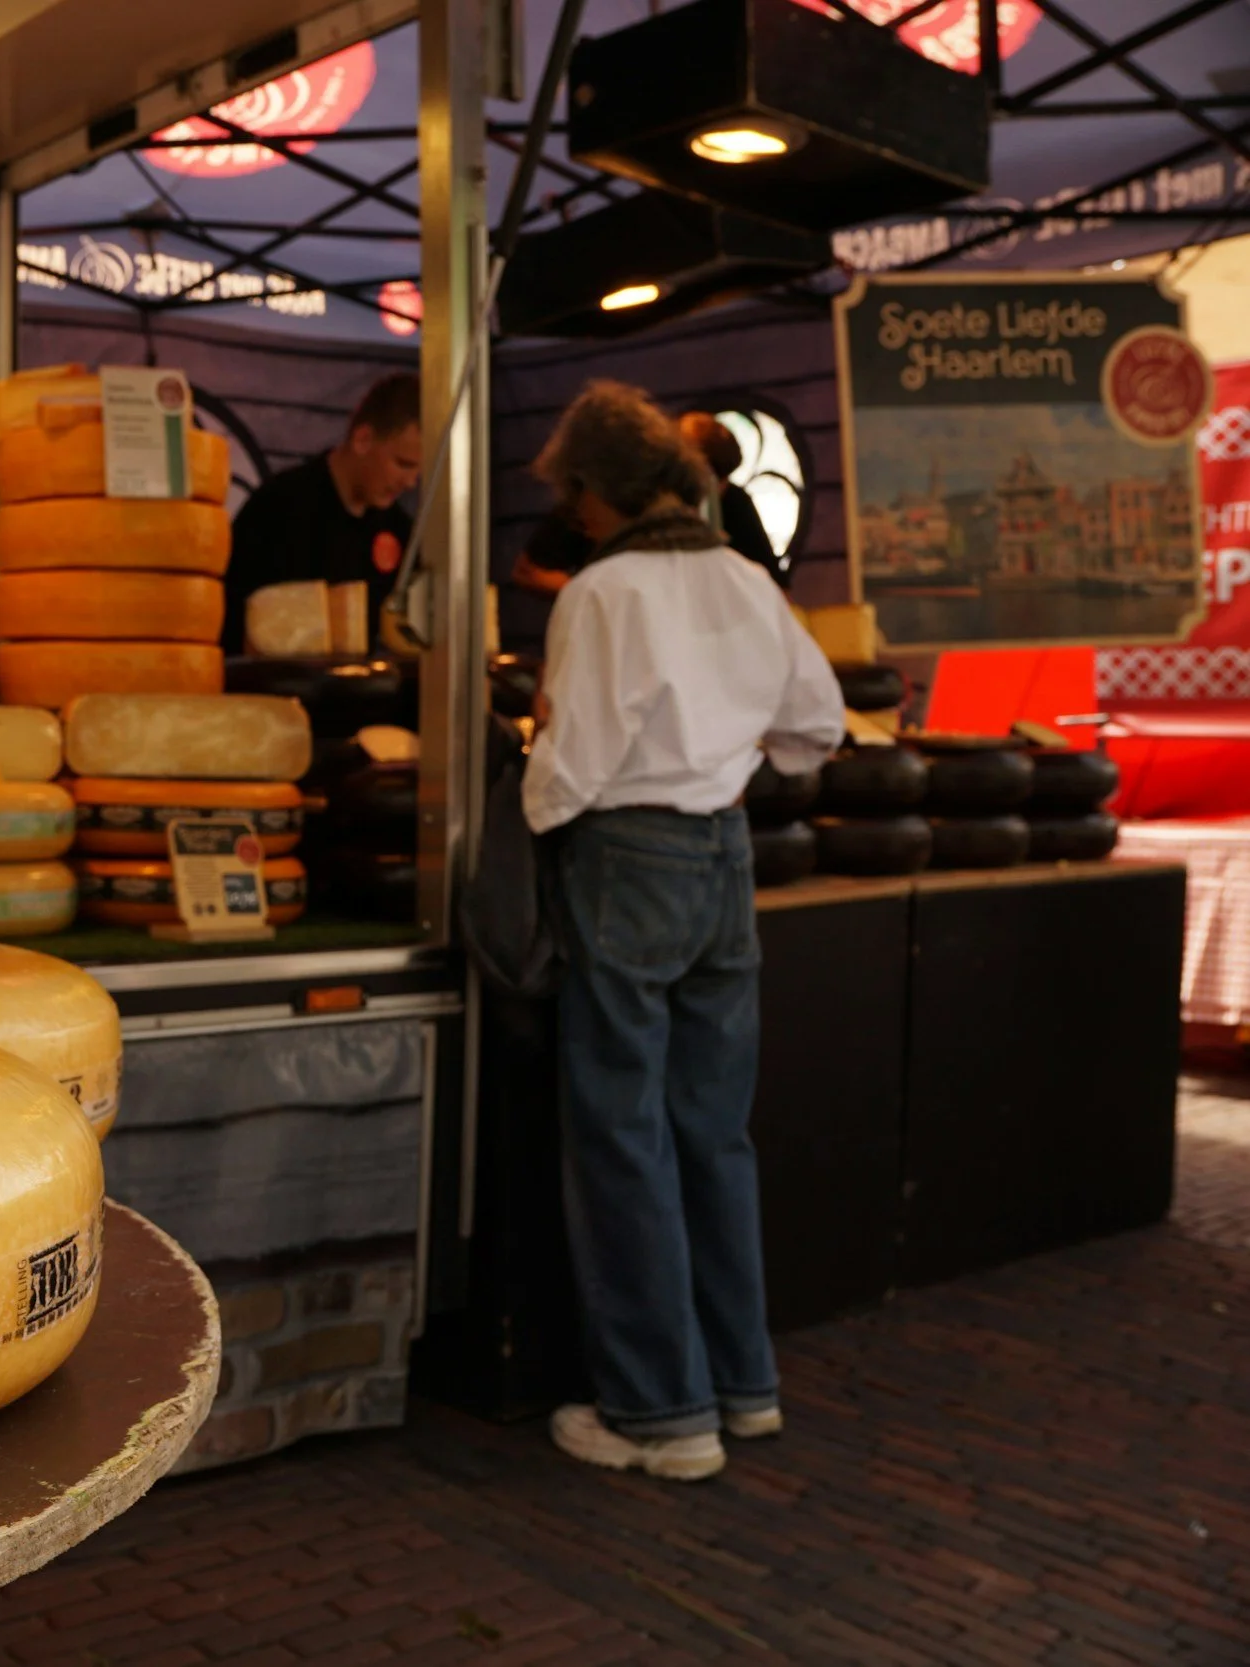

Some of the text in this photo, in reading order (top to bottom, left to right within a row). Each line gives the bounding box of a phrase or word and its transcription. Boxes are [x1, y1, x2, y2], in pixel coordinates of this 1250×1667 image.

[879, 301, 1106, 349] Soete Liefde
[901, 344, 1075, 391] Haarlem
[16, 1258, 28, 1327] STELLING
